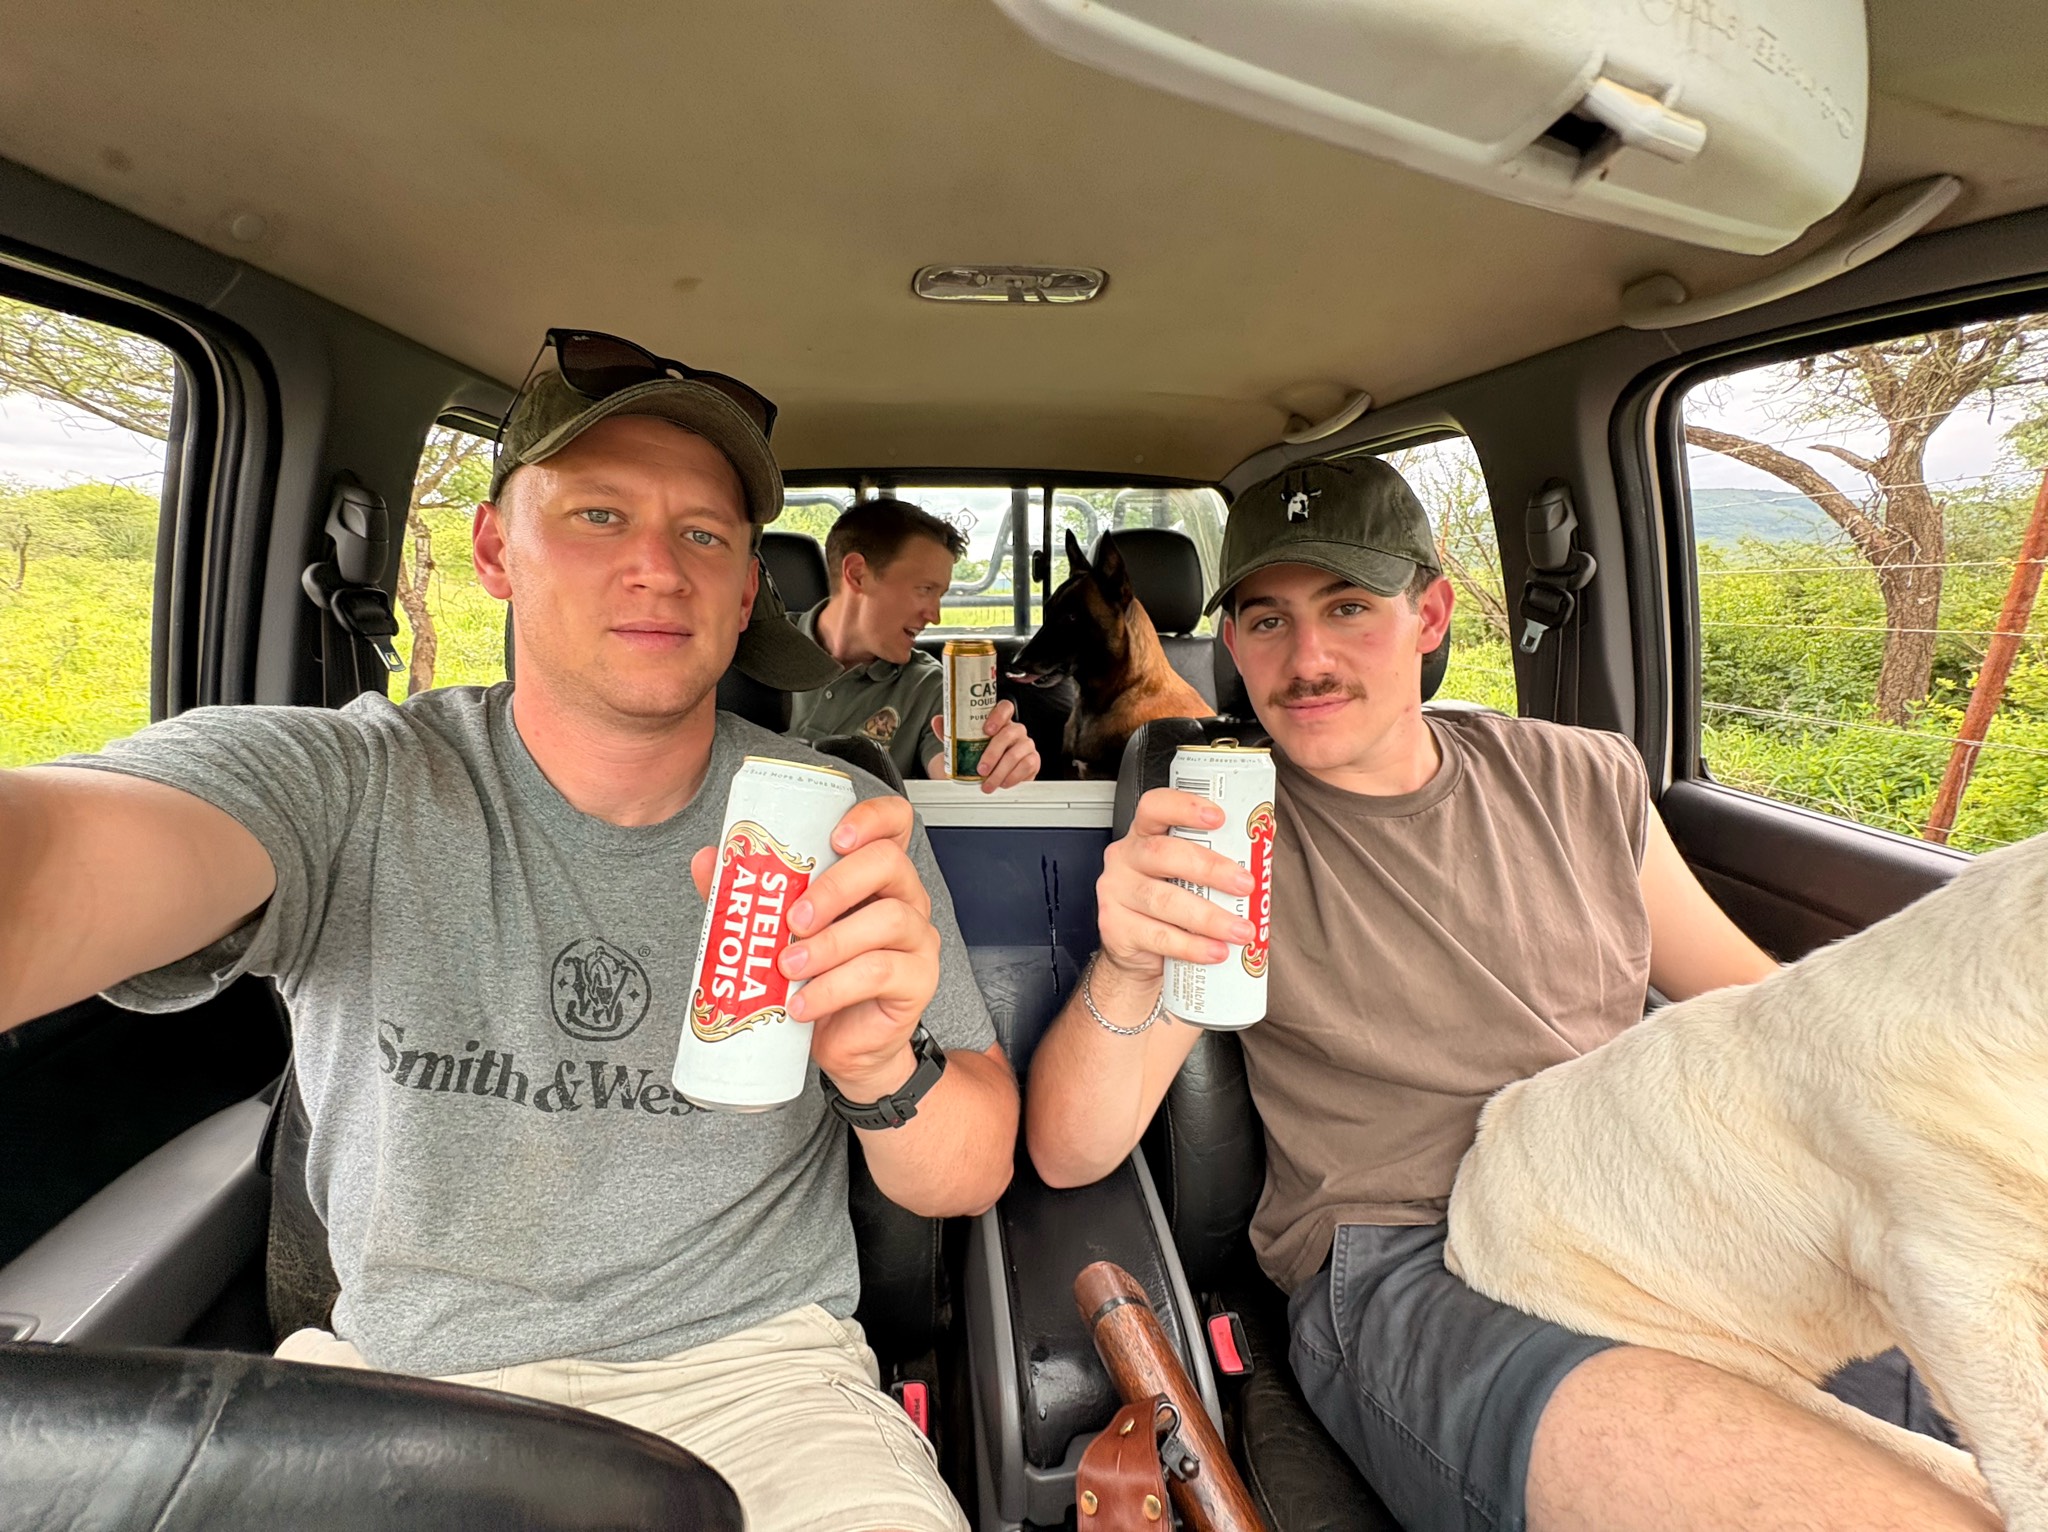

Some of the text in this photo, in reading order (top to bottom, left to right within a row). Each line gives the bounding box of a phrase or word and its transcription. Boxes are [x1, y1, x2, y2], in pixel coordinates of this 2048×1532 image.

[711, 863, 757, 999] ARTOIS
[738, 871, 788, 1002] STELLA
[1259, 837, 1273, 943] ARTOIS
[378, 1019, 716, 1117] Smith & Wes
